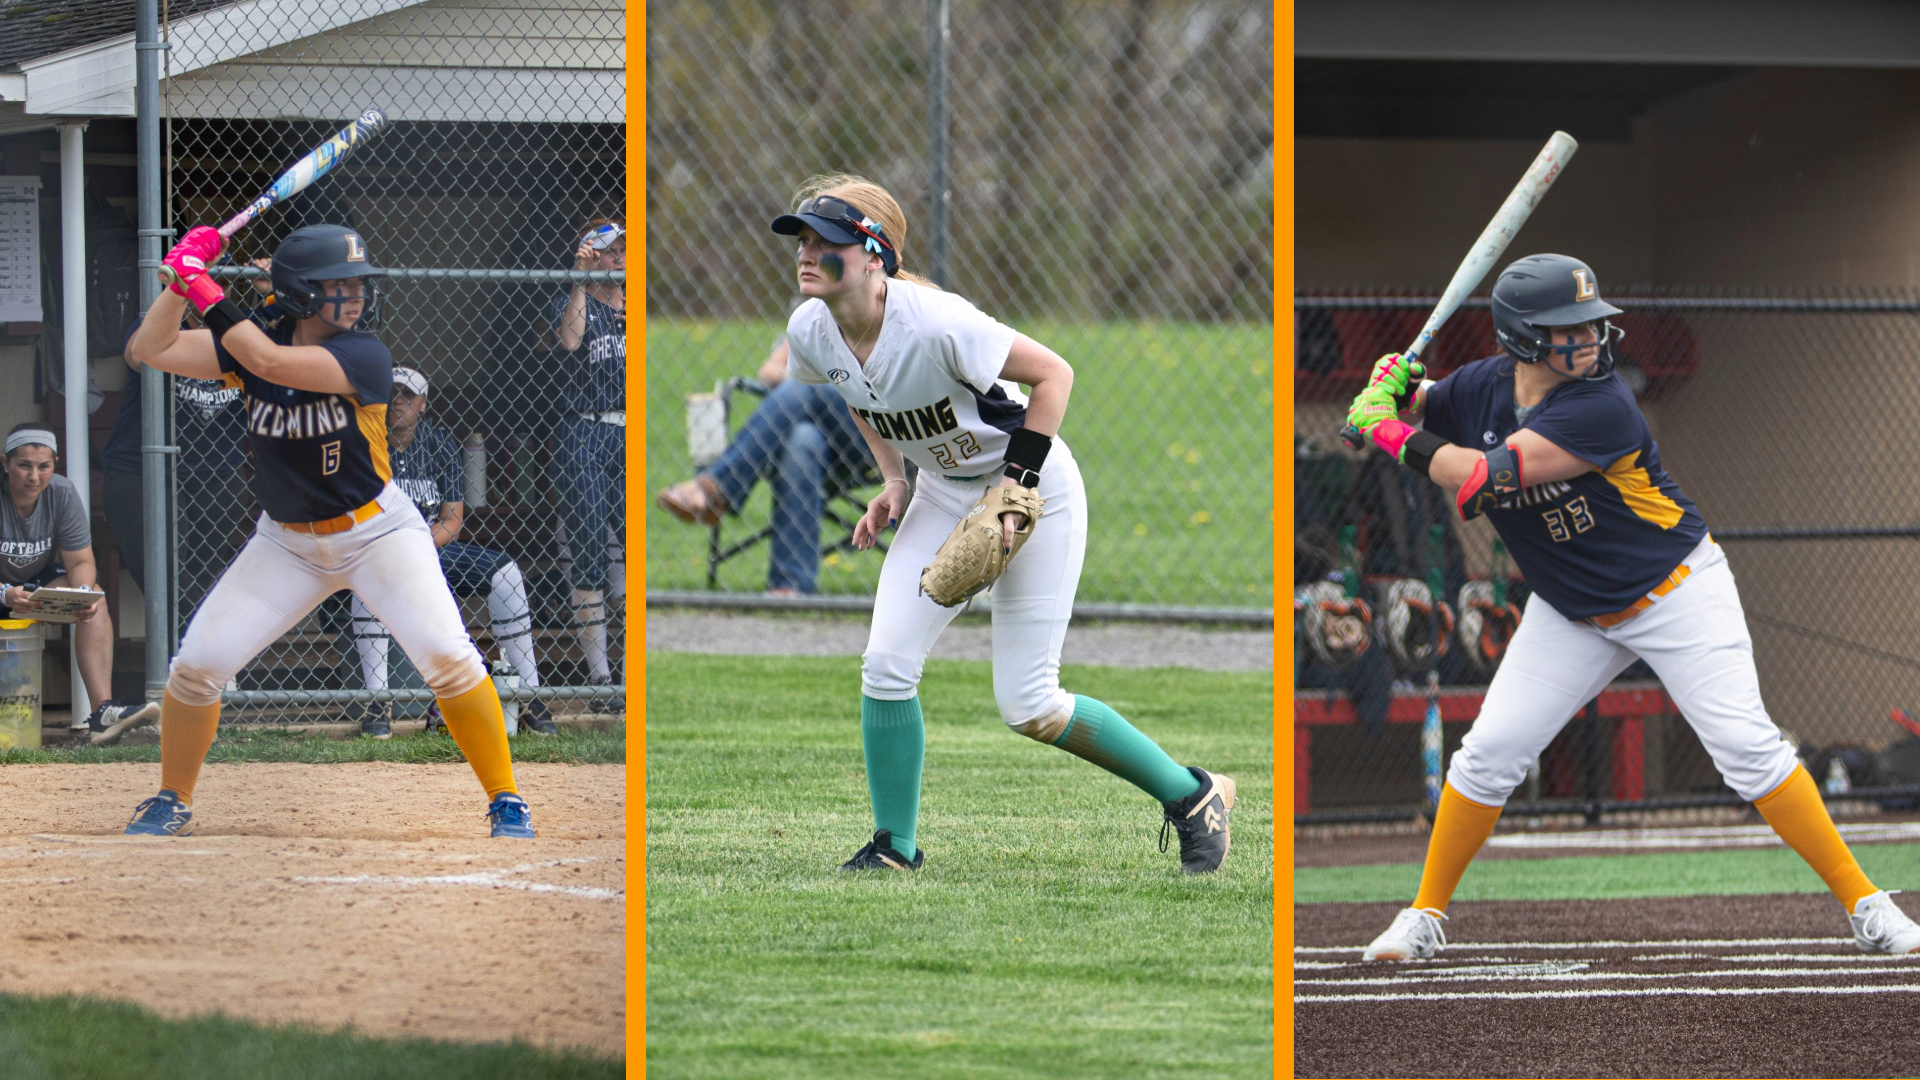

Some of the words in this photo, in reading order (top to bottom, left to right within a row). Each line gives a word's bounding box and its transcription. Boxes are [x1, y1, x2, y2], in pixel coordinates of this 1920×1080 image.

[345, 234, 366, 262] L
[1572, 269, 1596, 302] L
[850, 396, 958, 441] COMING
[321, 440, 341, 476] 6
[928, 430, 982, 470] 22
[1541, 495, 1595, 542] 33
[0, 537, 52, 555] OFTBALL
